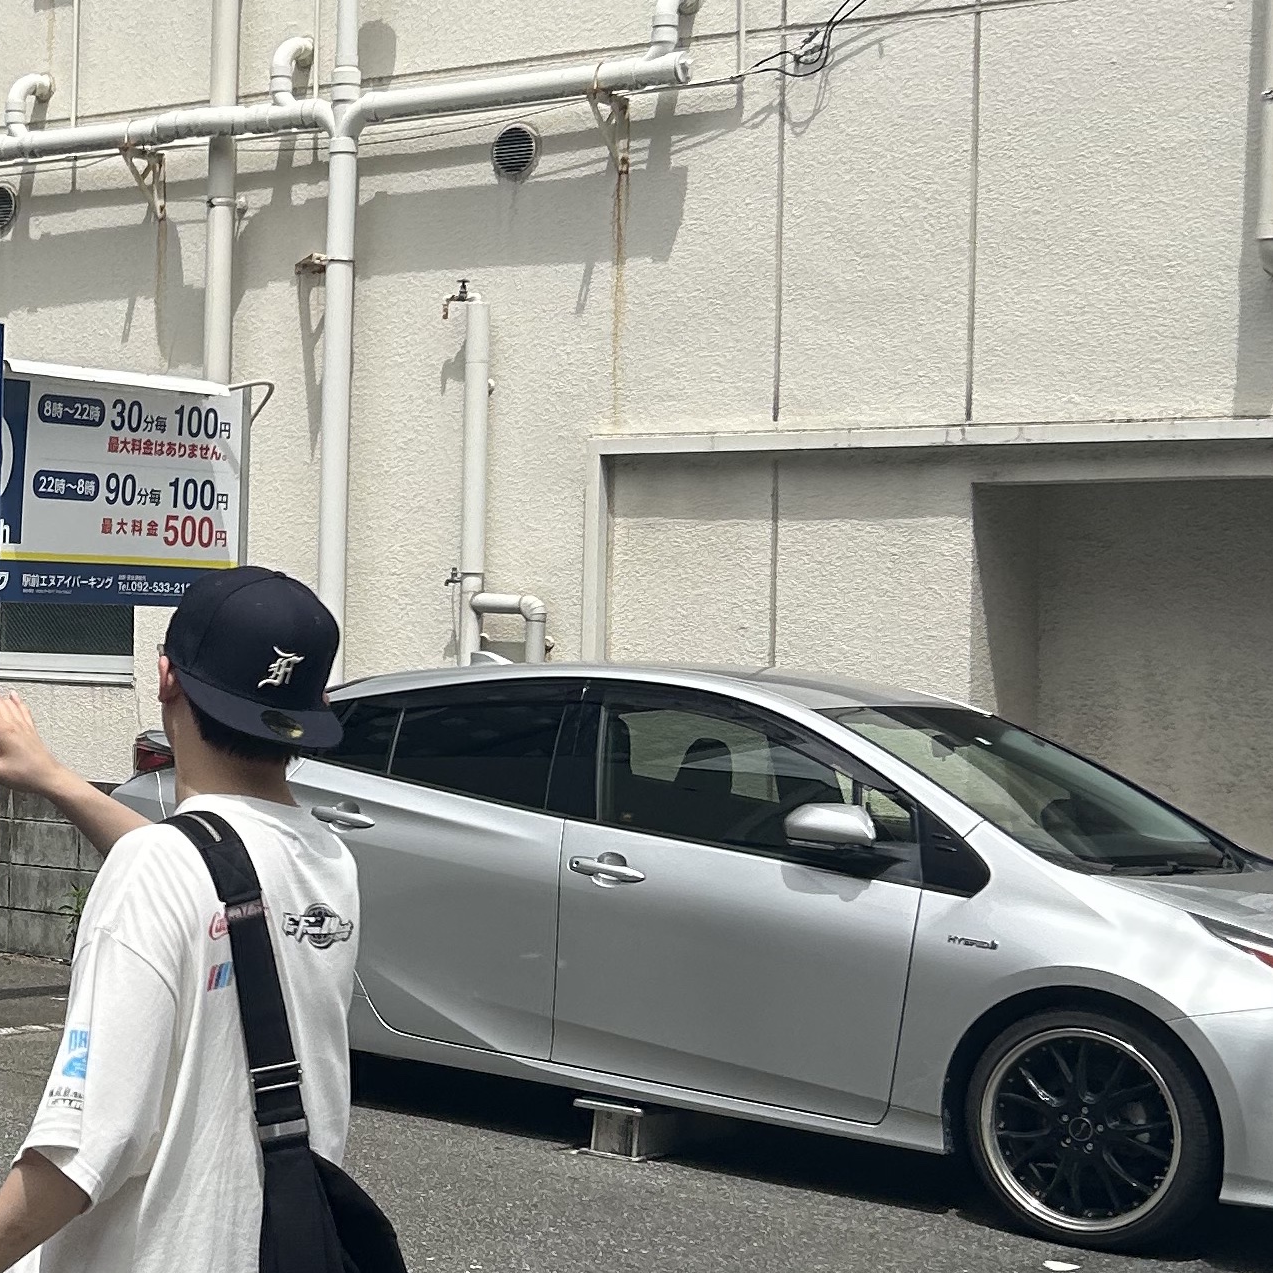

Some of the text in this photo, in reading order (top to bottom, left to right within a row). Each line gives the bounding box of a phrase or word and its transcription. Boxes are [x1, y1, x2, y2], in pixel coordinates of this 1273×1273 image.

[110, 399, 167, 434] 30分毎
[175, 404, 231, 440] 100円
[107, 436, 227, 462] 最大料金はありません。
[105, 472, 162, 507] 90分毎
[169, 477, 228, 511] 100円
[101, 514, 227, 548] 最大料金 500円
